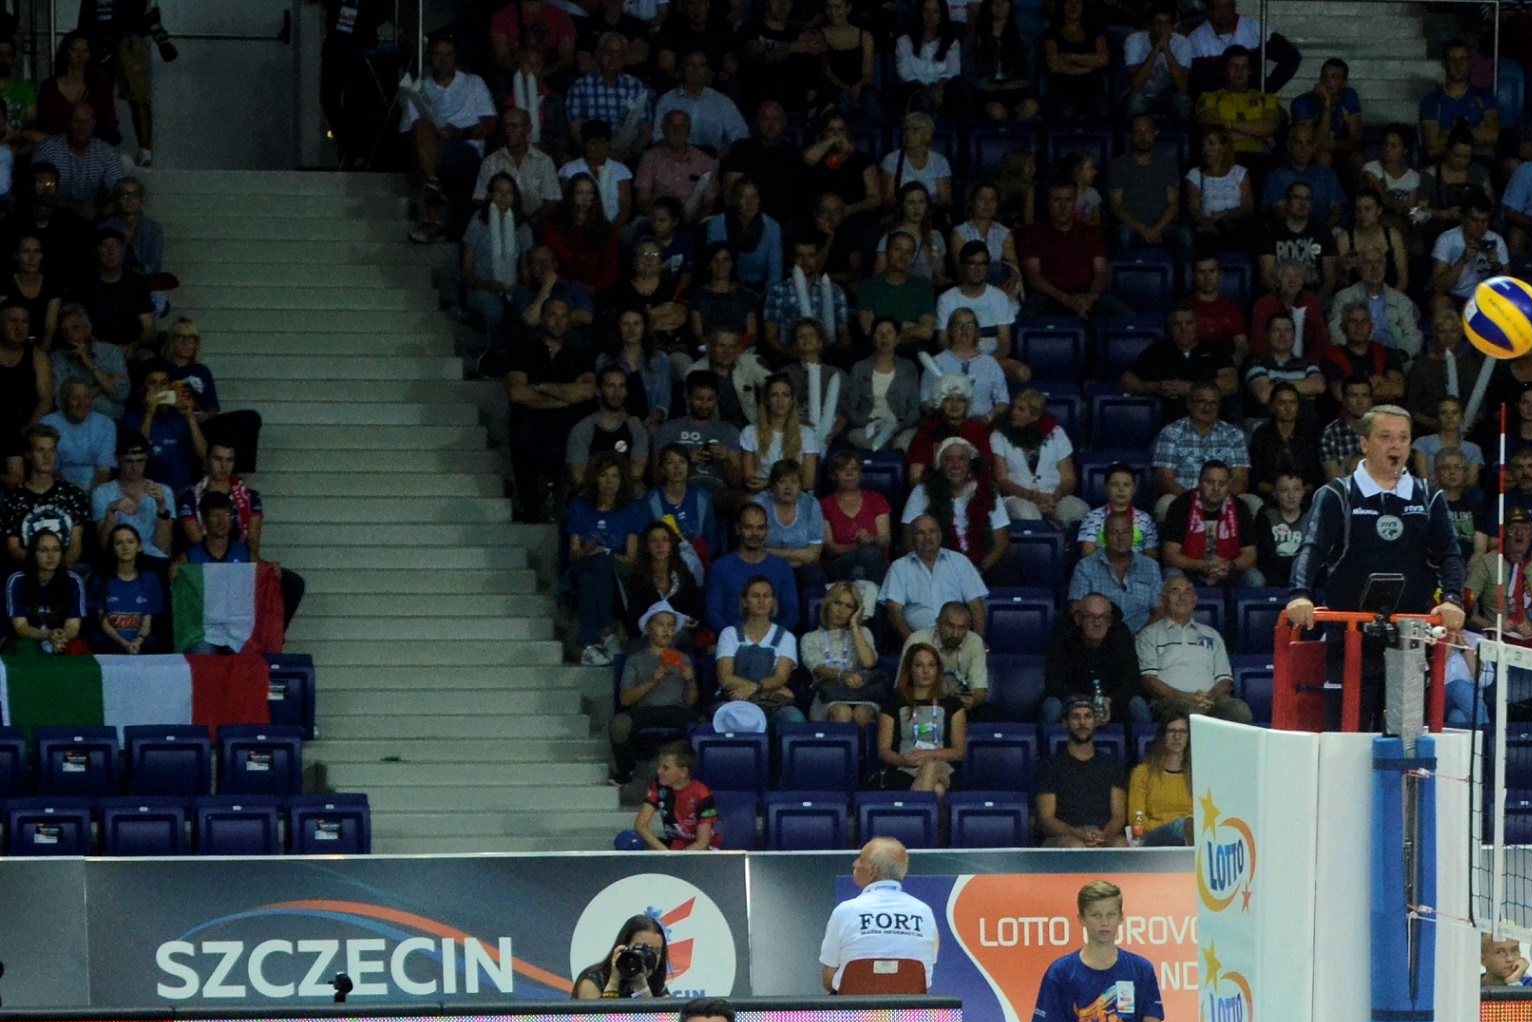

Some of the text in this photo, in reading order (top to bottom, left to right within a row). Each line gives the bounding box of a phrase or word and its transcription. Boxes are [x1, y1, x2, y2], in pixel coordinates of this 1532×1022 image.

[681, 431, 702, 441] DO
[1206, 839, 1244, 891] LOTTO
[859, 913, 923, 931] FORT
[979, 916, 1069, 946] LOTTO
[155, 937, 514, 999] SZCZECIN
